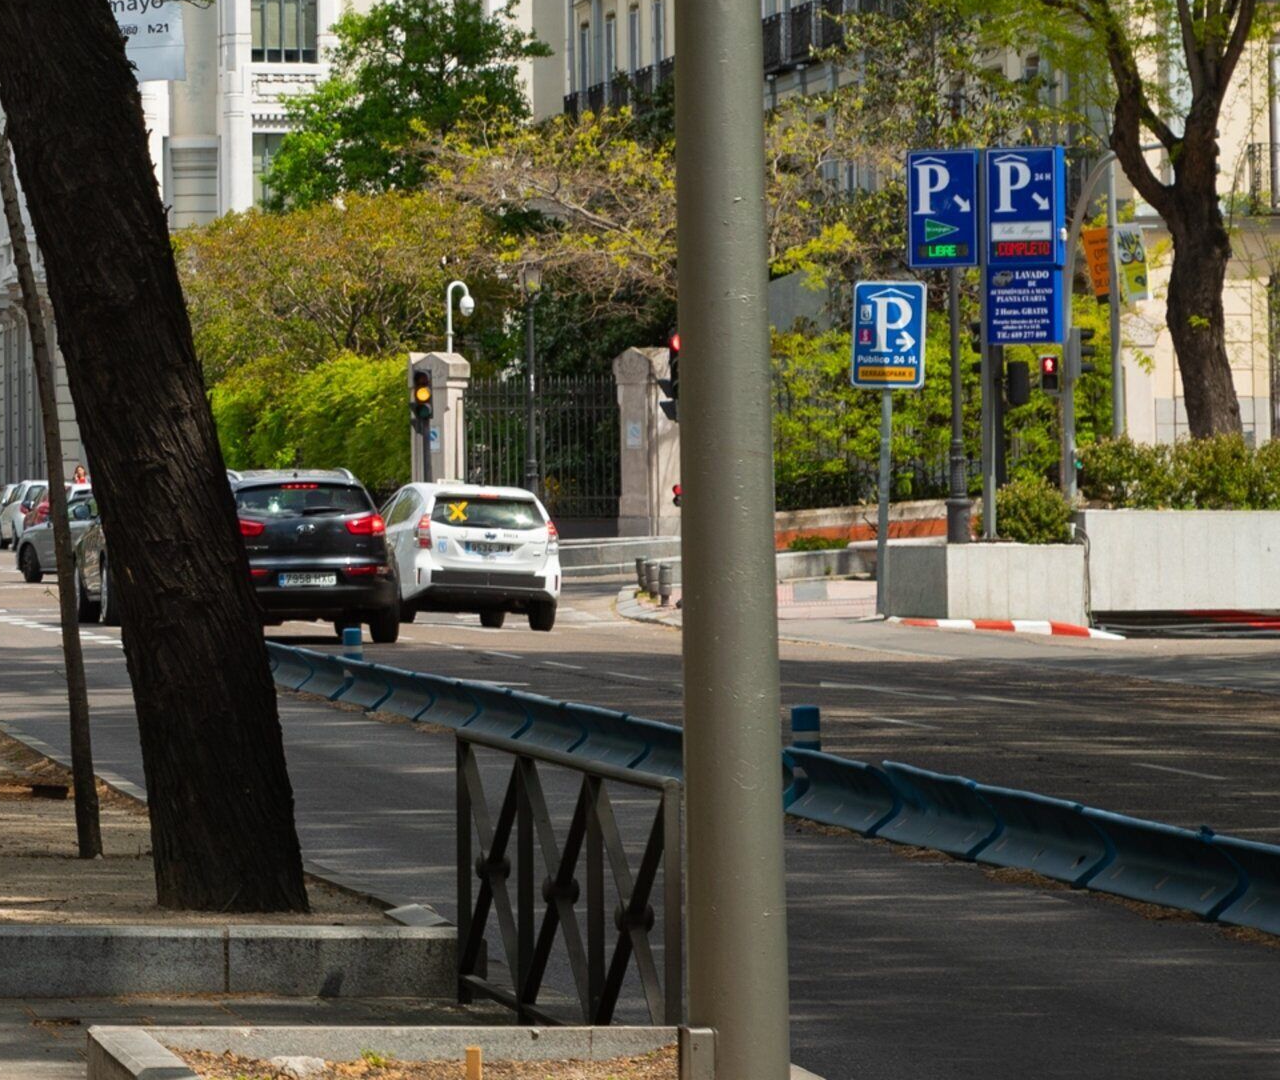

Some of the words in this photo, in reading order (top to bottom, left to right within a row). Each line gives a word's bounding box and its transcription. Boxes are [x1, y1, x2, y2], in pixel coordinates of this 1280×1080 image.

[929, 245, 957, 257] LIBRE
[997, 241, 1050, 256] COMPLETO
[1015, 271, 1049, 280] LAVADO
[996, 295, 1021, 303] PLANTA
[1021, 307, 1048, 315] GRATIS
[857, 354, 890, 364] Público
[893, 355, 905, 364] 24
[286, 573, 311, 584] 7958
